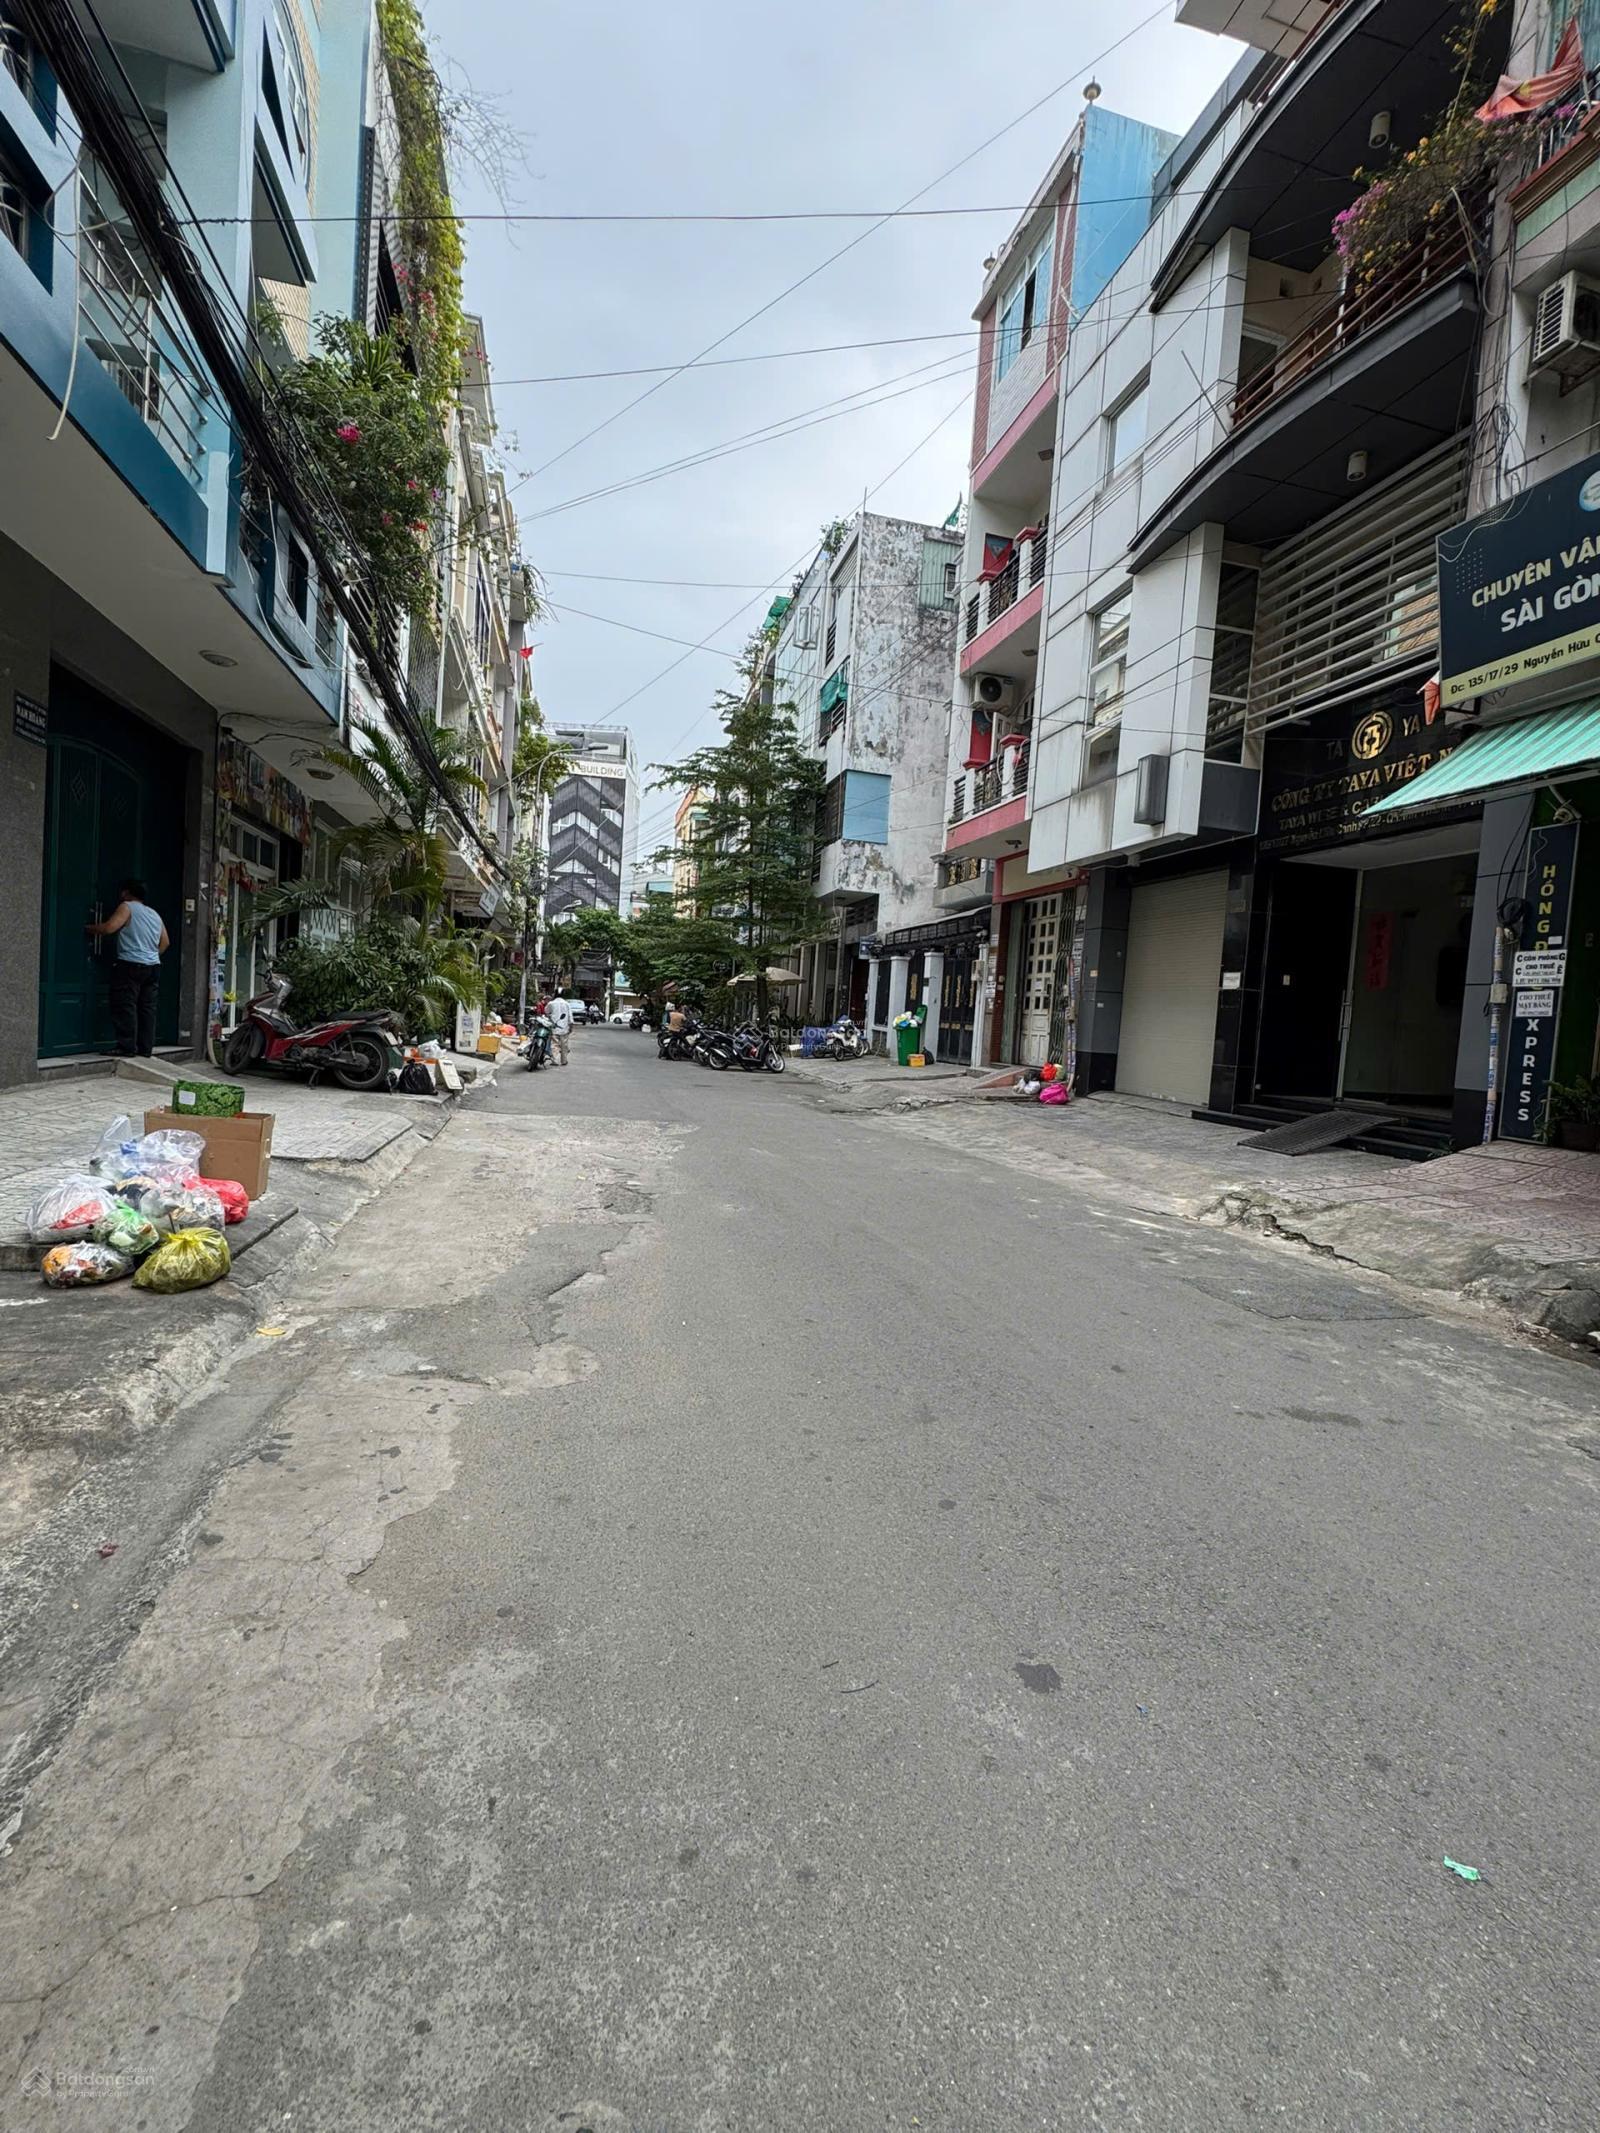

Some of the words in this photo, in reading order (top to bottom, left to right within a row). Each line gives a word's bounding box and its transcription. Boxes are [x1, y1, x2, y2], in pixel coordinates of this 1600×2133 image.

[1471, 558, 1551, 608] CHUYÊN
[1501, 596, 1544, 633] SÀI
[1468, 662, 1519, 688] 135/17/29
[1402, 714, 1421, 737] YA
[581, 764, 624, 777] BUILDING
[1271, 787, 1313, 813] CÔNG
[1338, 768, 1381, 796] TAYA
[1517, 1018, 1540, 1122] XPRESS
